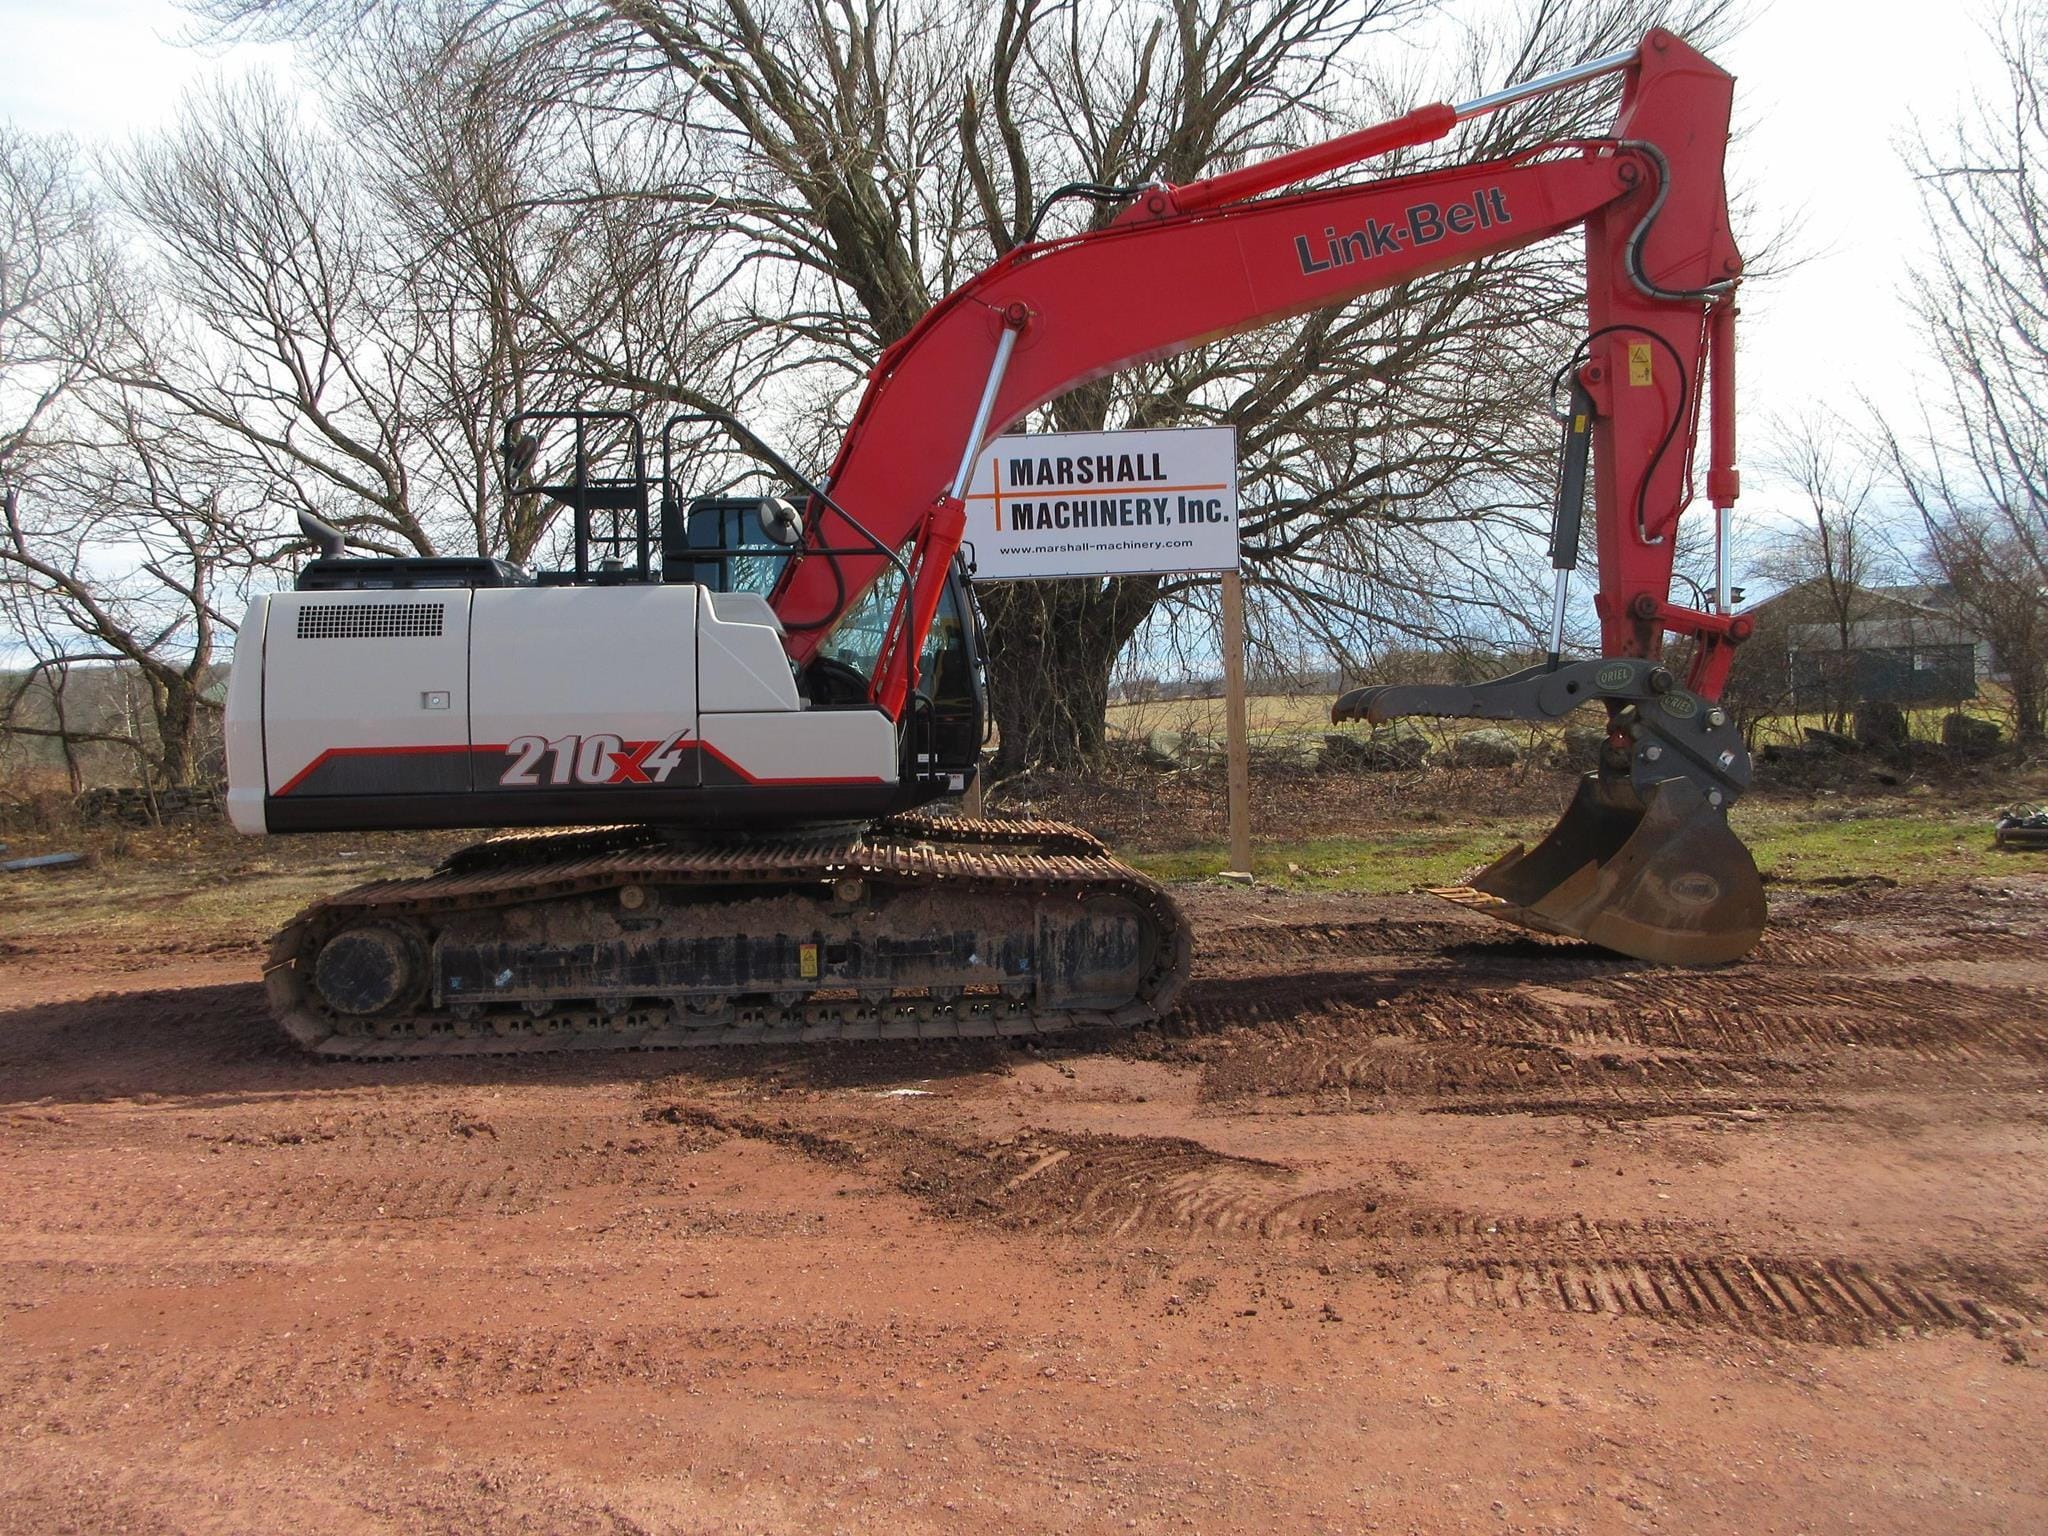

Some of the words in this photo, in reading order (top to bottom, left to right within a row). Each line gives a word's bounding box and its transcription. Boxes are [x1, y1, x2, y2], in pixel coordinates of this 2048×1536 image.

[1294, 186, 1512, 275] Link-Belt
[1009, 453, 1168, 487] MARSHALL
[1010, 497, 1171, 531] MACHINERY,
[1177, 496, 1229, 524] Inc.
[1000, 538, 1193, 555] www.marshall-machinery.com
